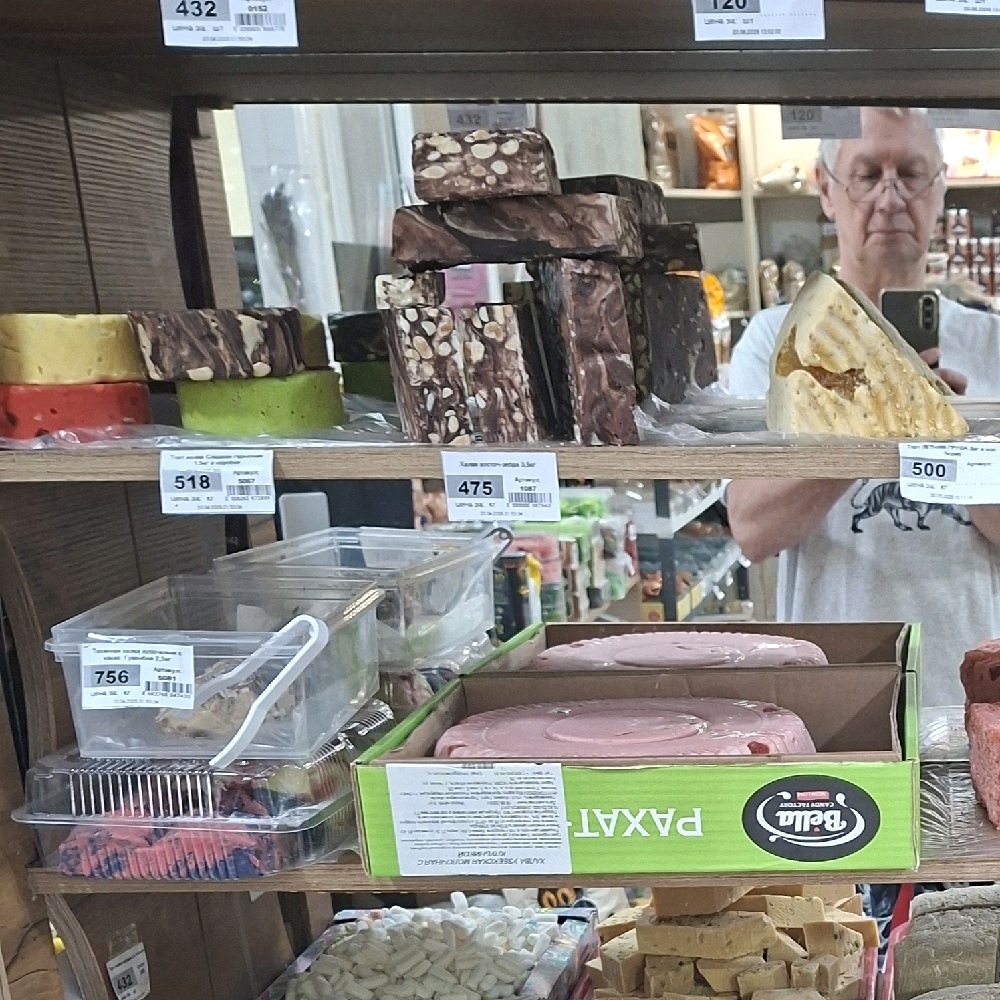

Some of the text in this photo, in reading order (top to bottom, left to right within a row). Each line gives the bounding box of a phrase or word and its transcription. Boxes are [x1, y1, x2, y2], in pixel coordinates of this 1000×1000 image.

[175, 0, 218, 18] 432
[912, 462, 946, 478] 500
[174, 474, 210, 490] 518
[458, 480, 493, 496] 475
[94, 670, 129, 685] 756
[774, 809, 847, 834] Bella
[117, 974, 133, 990] 432
